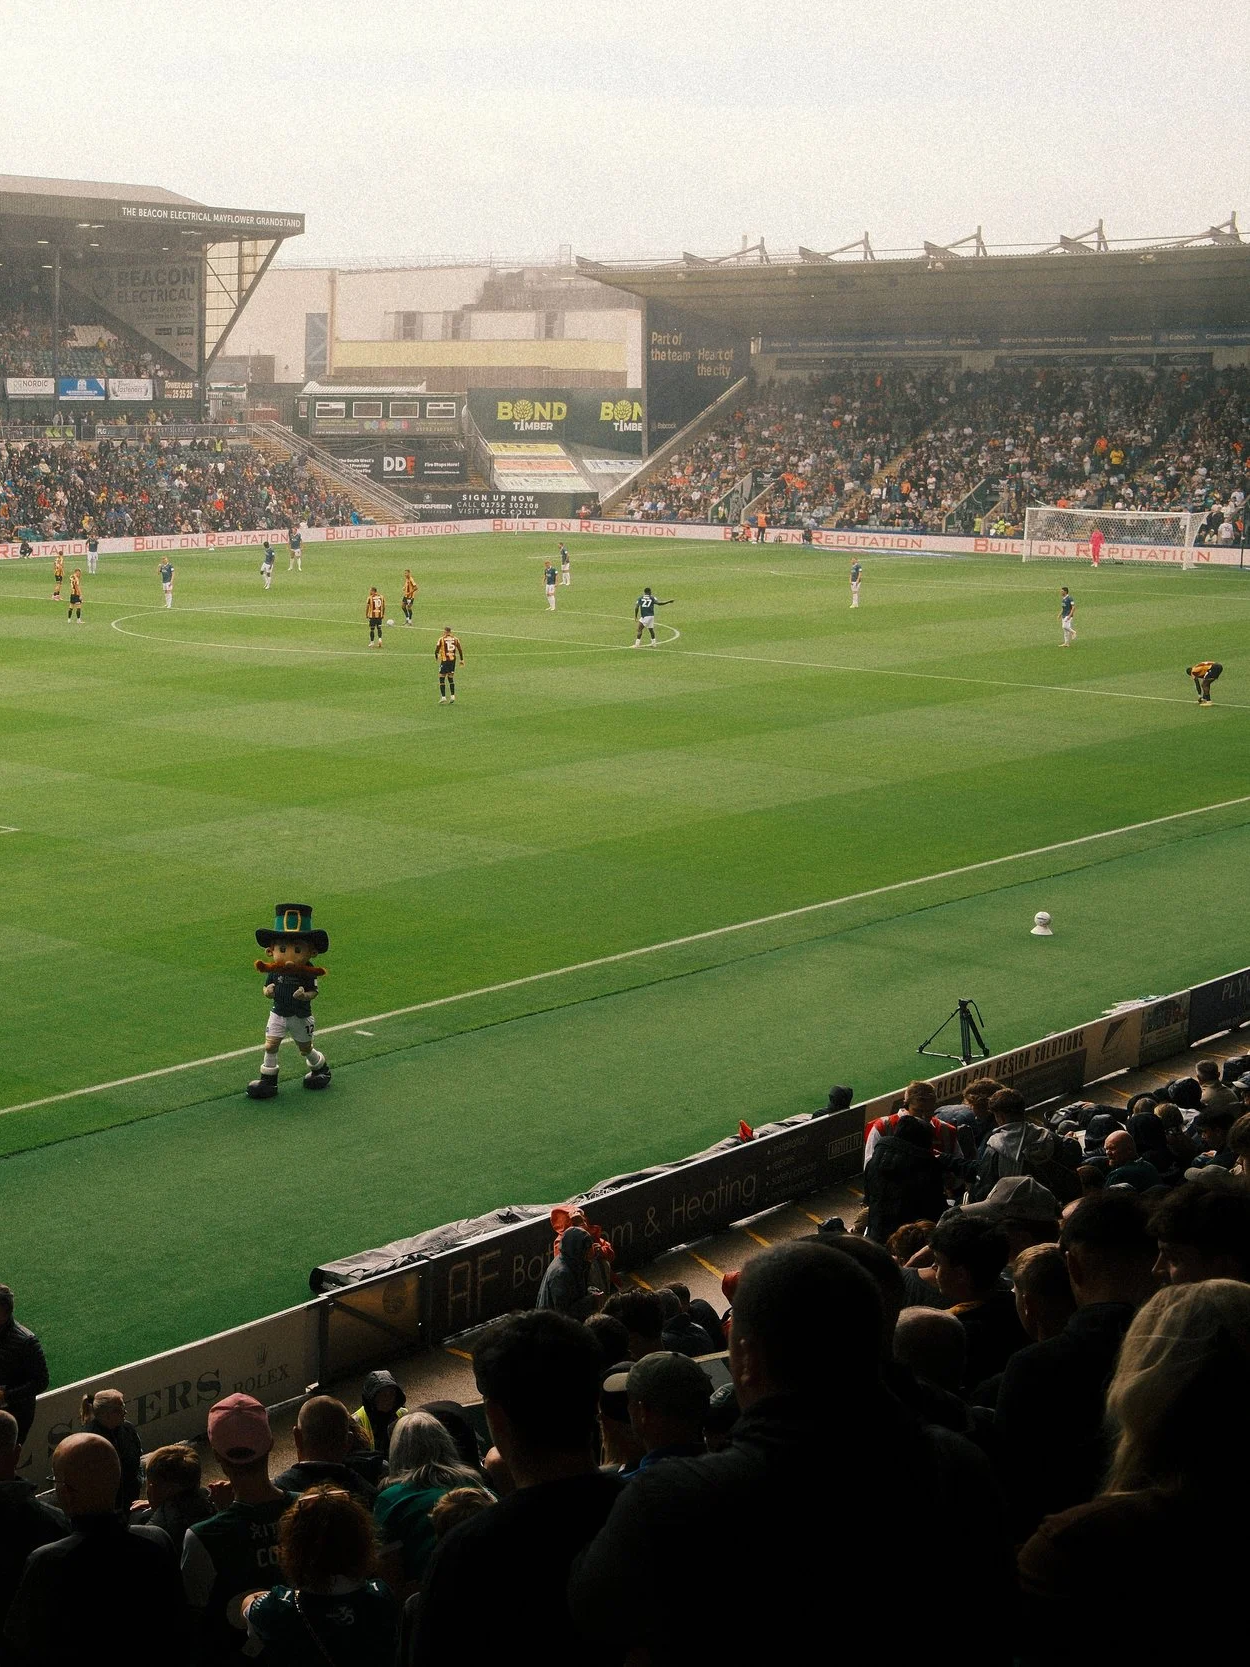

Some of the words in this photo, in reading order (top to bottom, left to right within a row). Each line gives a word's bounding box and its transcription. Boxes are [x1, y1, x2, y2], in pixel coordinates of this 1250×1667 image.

[122, 207, 136, 217] THE
[138, 208, 168, 219] BEACON
[170, 211, 212, 222] ELECTRICAL
[213, 213, 255, 225] MAYFLOWER
[256, 216, 301, 228] GRANDSTAND
[117, 266, 196, 287] BEACON
[116, 288, 195, 303] ELECTRICAL
[651, 332, 670, 345] Part
[672, 332, 683, 345] of
[651, 349, 666, 361] the
[668, 351, 691, 361] team
[698, 349, 723, 361] Heart
[724, 348, 734, 361] of
[697, 364, 712, 376] the
[713, 365, 732, 378] city
[172, 390, 179, 398] 25
[180, 390, 186, 398] 25
[186, 390, 193, 398] 25
[497, 400, 567, 421] BOND
[600, 400, 642, 421] BON
[513, 421, 553, 431] TIMBER
[613, 421, 642, 431] TIMBE
[383, 456, 415, 474] DDF
[326, 527, 363, 540] BUILT
[366, 528, 383, 538] ON
[388, 523, 460, 537] REPUTATION
[493, 519, 538, 532] BUILT
[546, 521, 572, 531] ON
[580, 520, 676, 537] REPUTATION
[134, 537, 178, 551] BUILT
[181, 537, 199, 548] ON
[205, 526, 288, 547] REPUTATION
[781, 534, 801, 543] ON
[812, 532, 923, 548] REPUTATION
[1039, 544, 1066, 556] ON
[1076, 543, 1210, 562] RPUTATION
[373, 599, 382, 608] 10
[641, 599, 652, 608] 27
[445, 640, 455, 651] 15
[996, 1050, 1031, 1077] DESIGN
[1034, 1031, 1085, 1063] SOLUTIONS
[449, 1250, 502, 1322] AF
[512, 1222, 634, 1289] Batom
[644, 1207, 660, 1238] &
[671, 1172, 757, 1228] Heating
[234, 1363, 291, 1393] ROLEX
